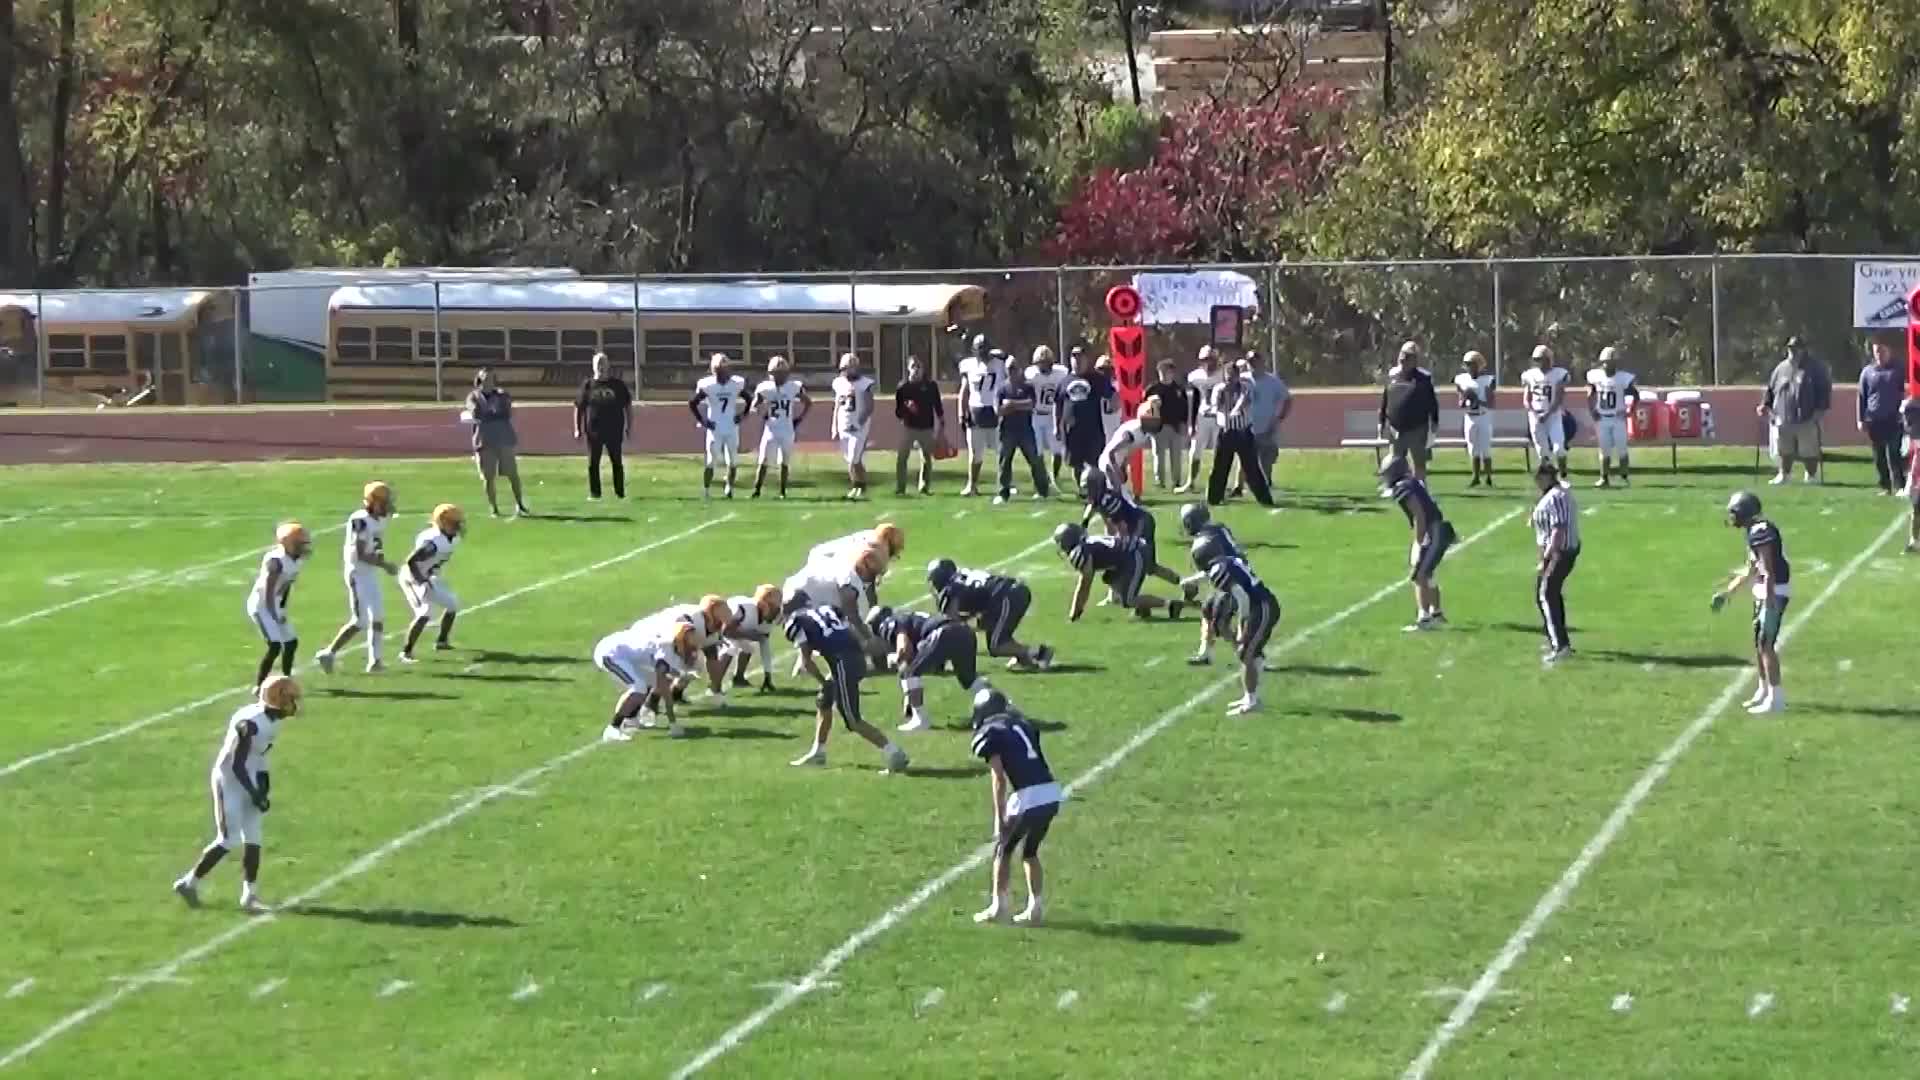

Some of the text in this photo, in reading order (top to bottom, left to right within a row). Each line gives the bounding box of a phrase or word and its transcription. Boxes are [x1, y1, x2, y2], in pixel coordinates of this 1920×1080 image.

[719, 398, 729, 413] 7
[770, 400, 791, 418] 24
[1012, 724, 1038, 759] 1
